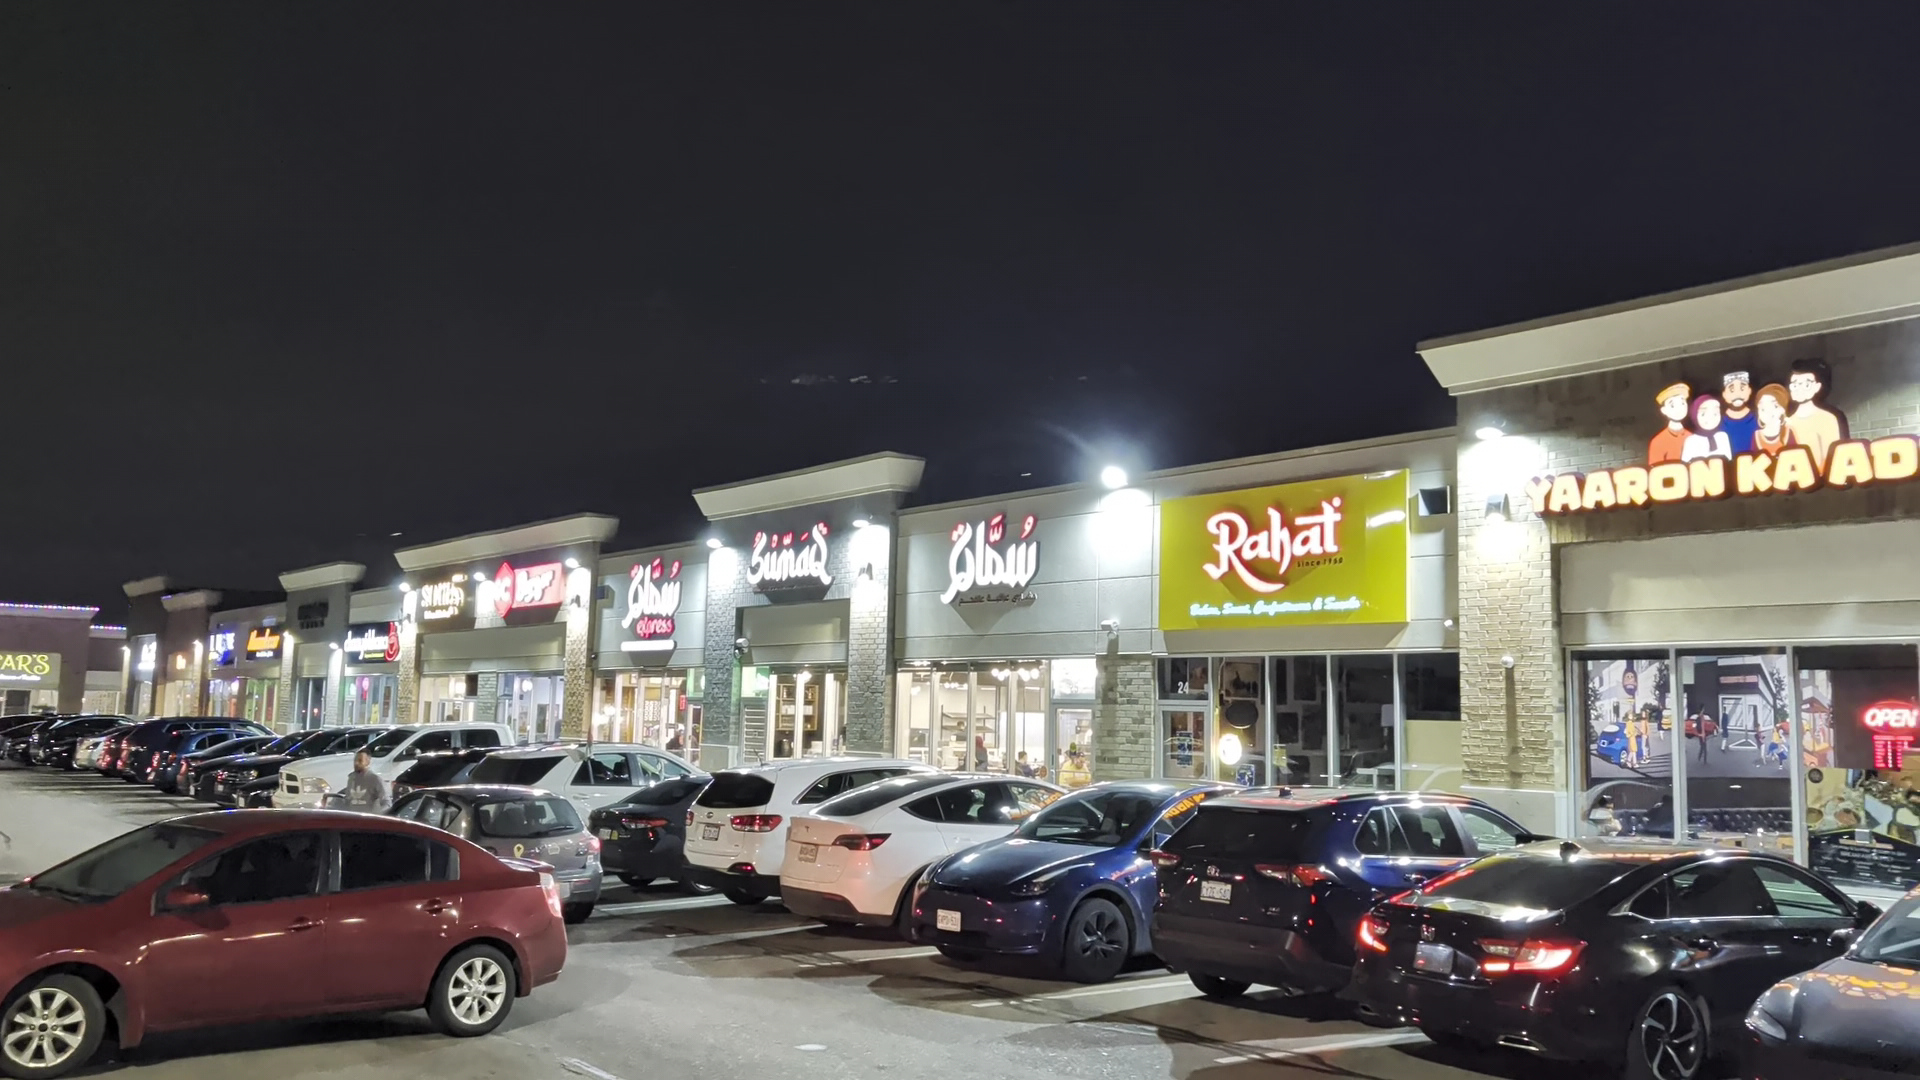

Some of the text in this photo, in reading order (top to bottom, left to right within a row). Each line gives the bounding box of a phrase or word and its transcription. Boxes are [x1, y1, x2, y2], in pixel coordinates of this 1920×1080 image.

[1525, 456, 1726, 513] YAARON
[1736, 447, 1815, 494] KA
[1202, 496, 1342, 593] Rahat
[0, 654, 50, 675] AR'S
[1177, 681, 1189, 694] 24
[1865, 708, 1919, 728] OPEN
